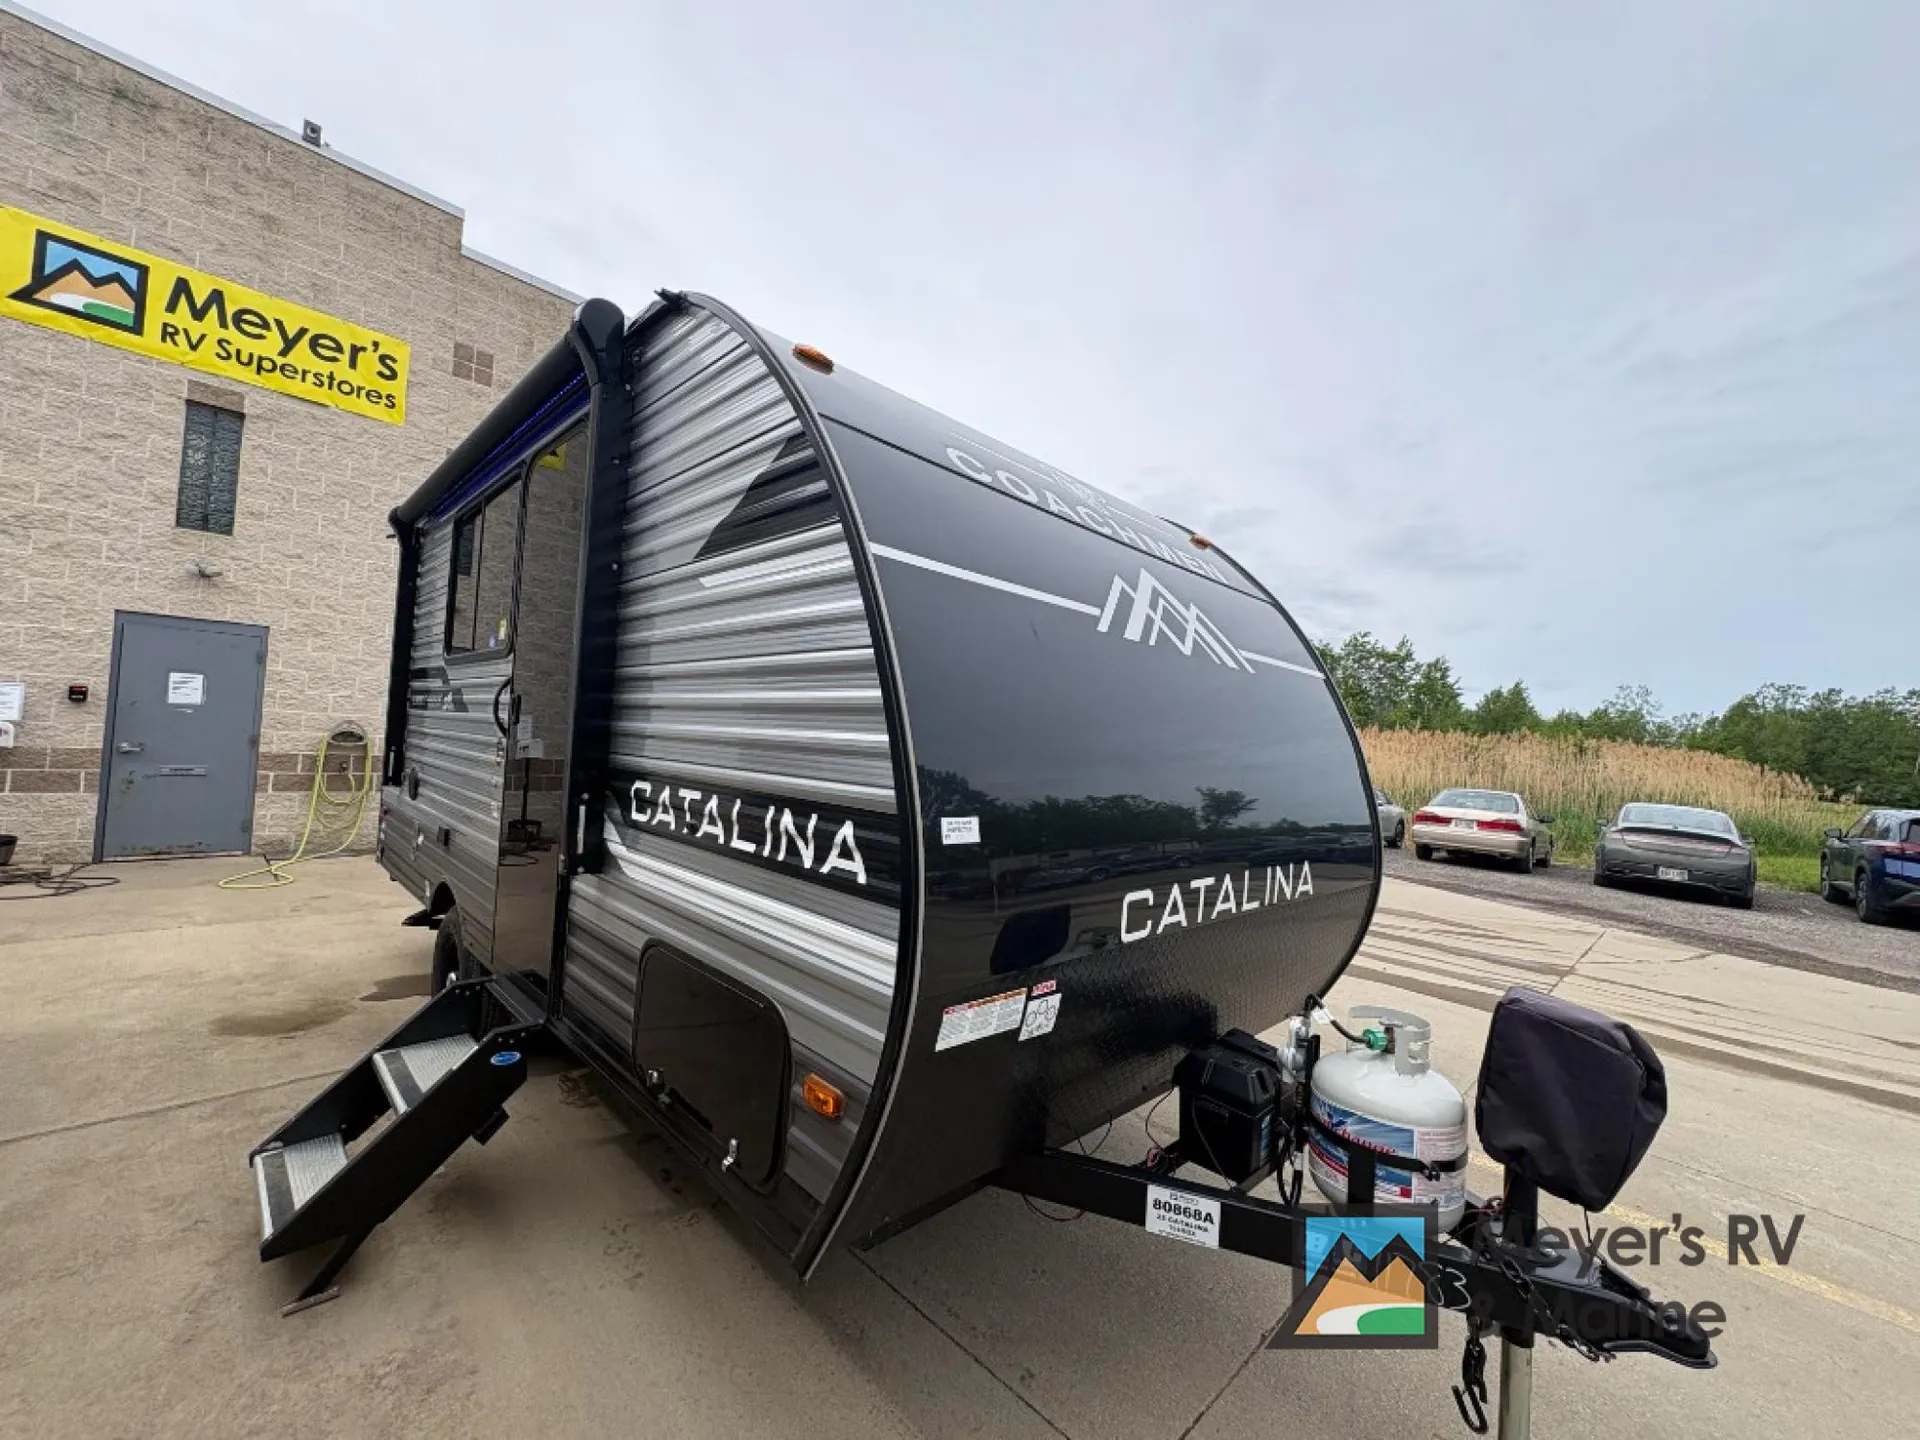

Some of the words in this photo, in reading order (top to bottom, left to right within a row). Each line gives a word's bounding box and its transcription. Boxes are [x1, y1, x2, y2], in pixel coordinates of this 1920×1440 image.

[161, 321, 207, 352] RV
[215, 338, 397, 410] Superstores
[165, 276, 399, 381] Meyer's
[946, 448, 1230, 585] COACHMEN
[631, 780, 867, 885] CATALINA
[1120, 860, 1314, 944] CATALINA
[1152, 1197, 1215, 1225] 80868A
